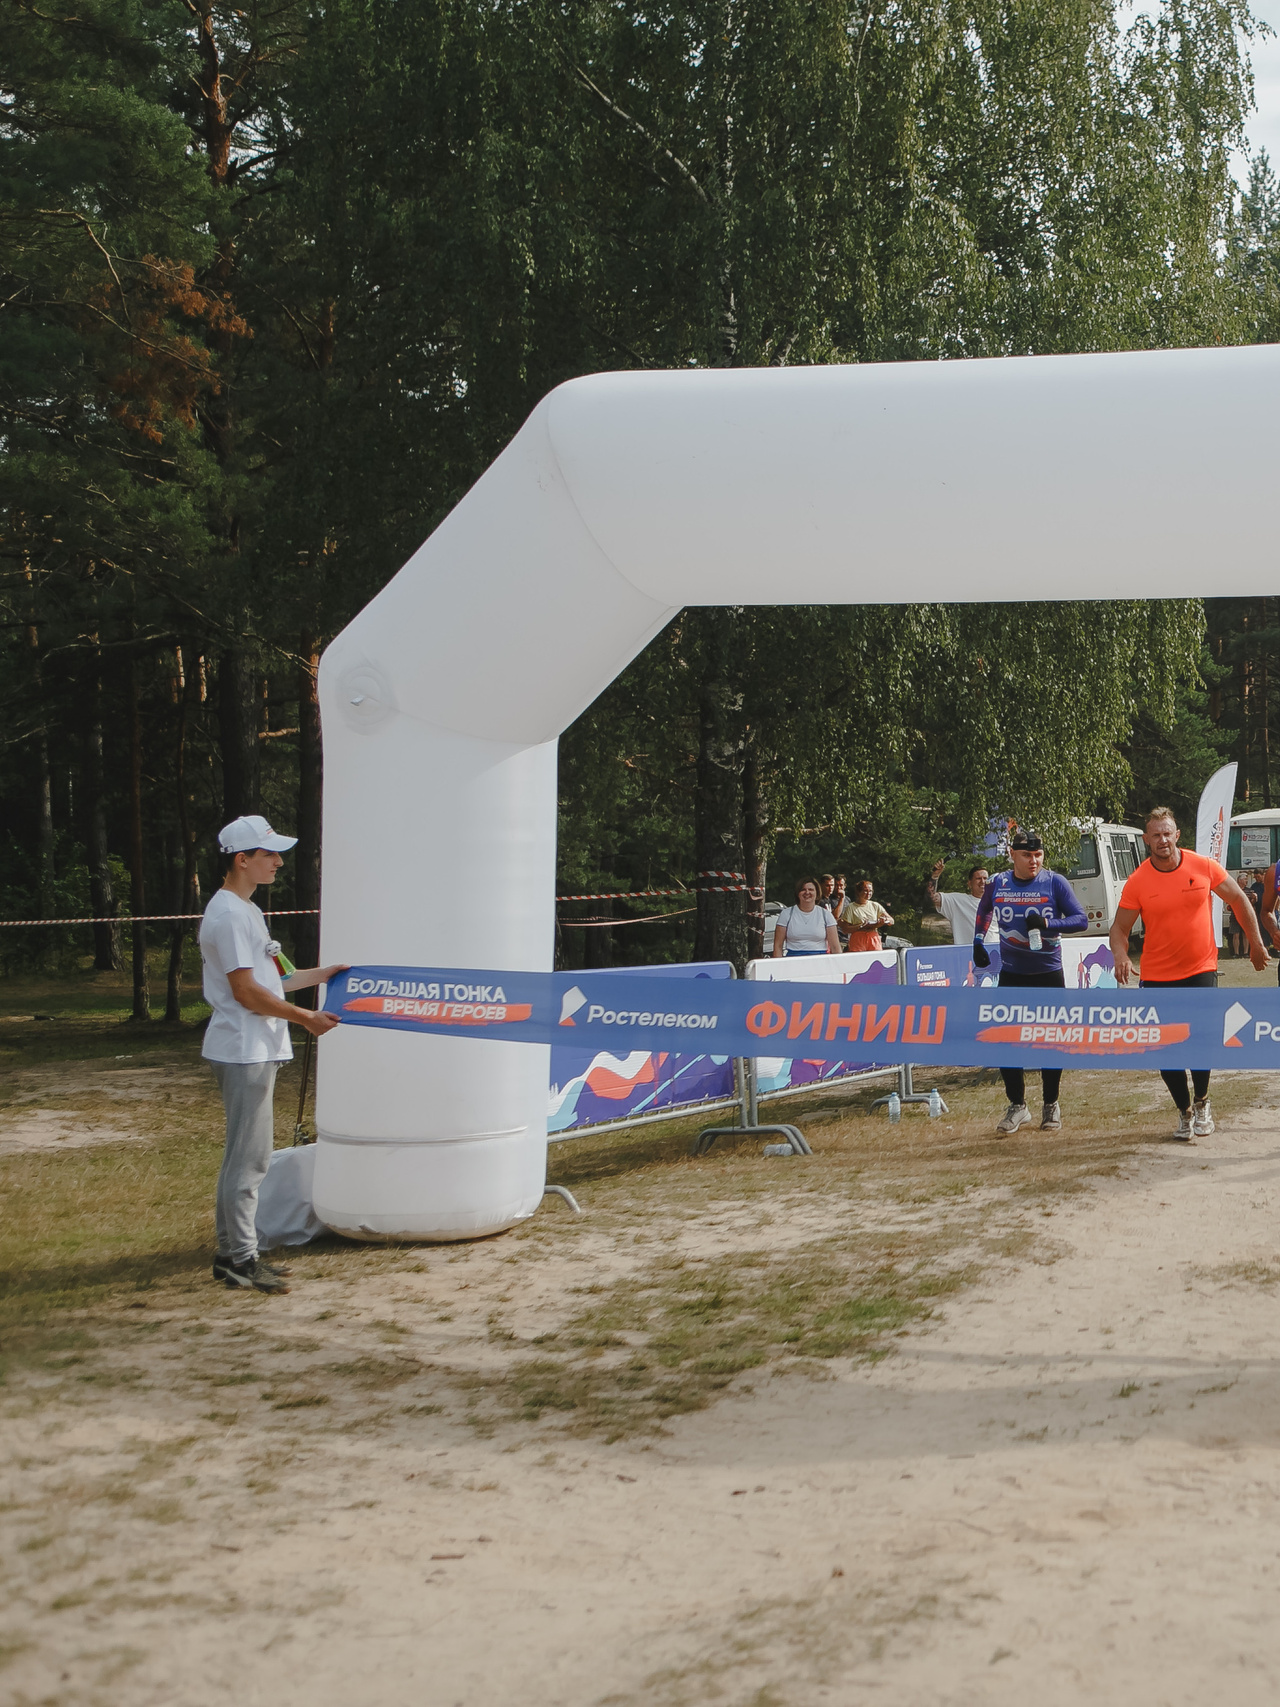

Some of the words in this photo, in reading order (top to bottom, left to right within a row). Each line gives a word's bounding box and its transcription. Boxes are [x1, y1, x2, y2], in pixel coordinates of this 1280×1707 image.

[346, 977, 440, 1000] БОЛЬШАЯ
[444, 982, 507, 1003] ГОНКА
[382, 998, 440, 1017] ВРЕМЯ
[441, 1003, 507, 1021] ГЕРОЕВ
[587, 1004, 718, 1030] Ростелеком
[978, 1003, 1084, 1025] БОЛЬШАЯ
[1088, 1005, 1160, 1025] ГОНКА
[745, 1000, 948, 1045] ФИНИШ
[1020, 1026, 1084, 1043] ВРЕМЯ
[1088, 1026, 1161, 1044] ГЕРОЕВ
